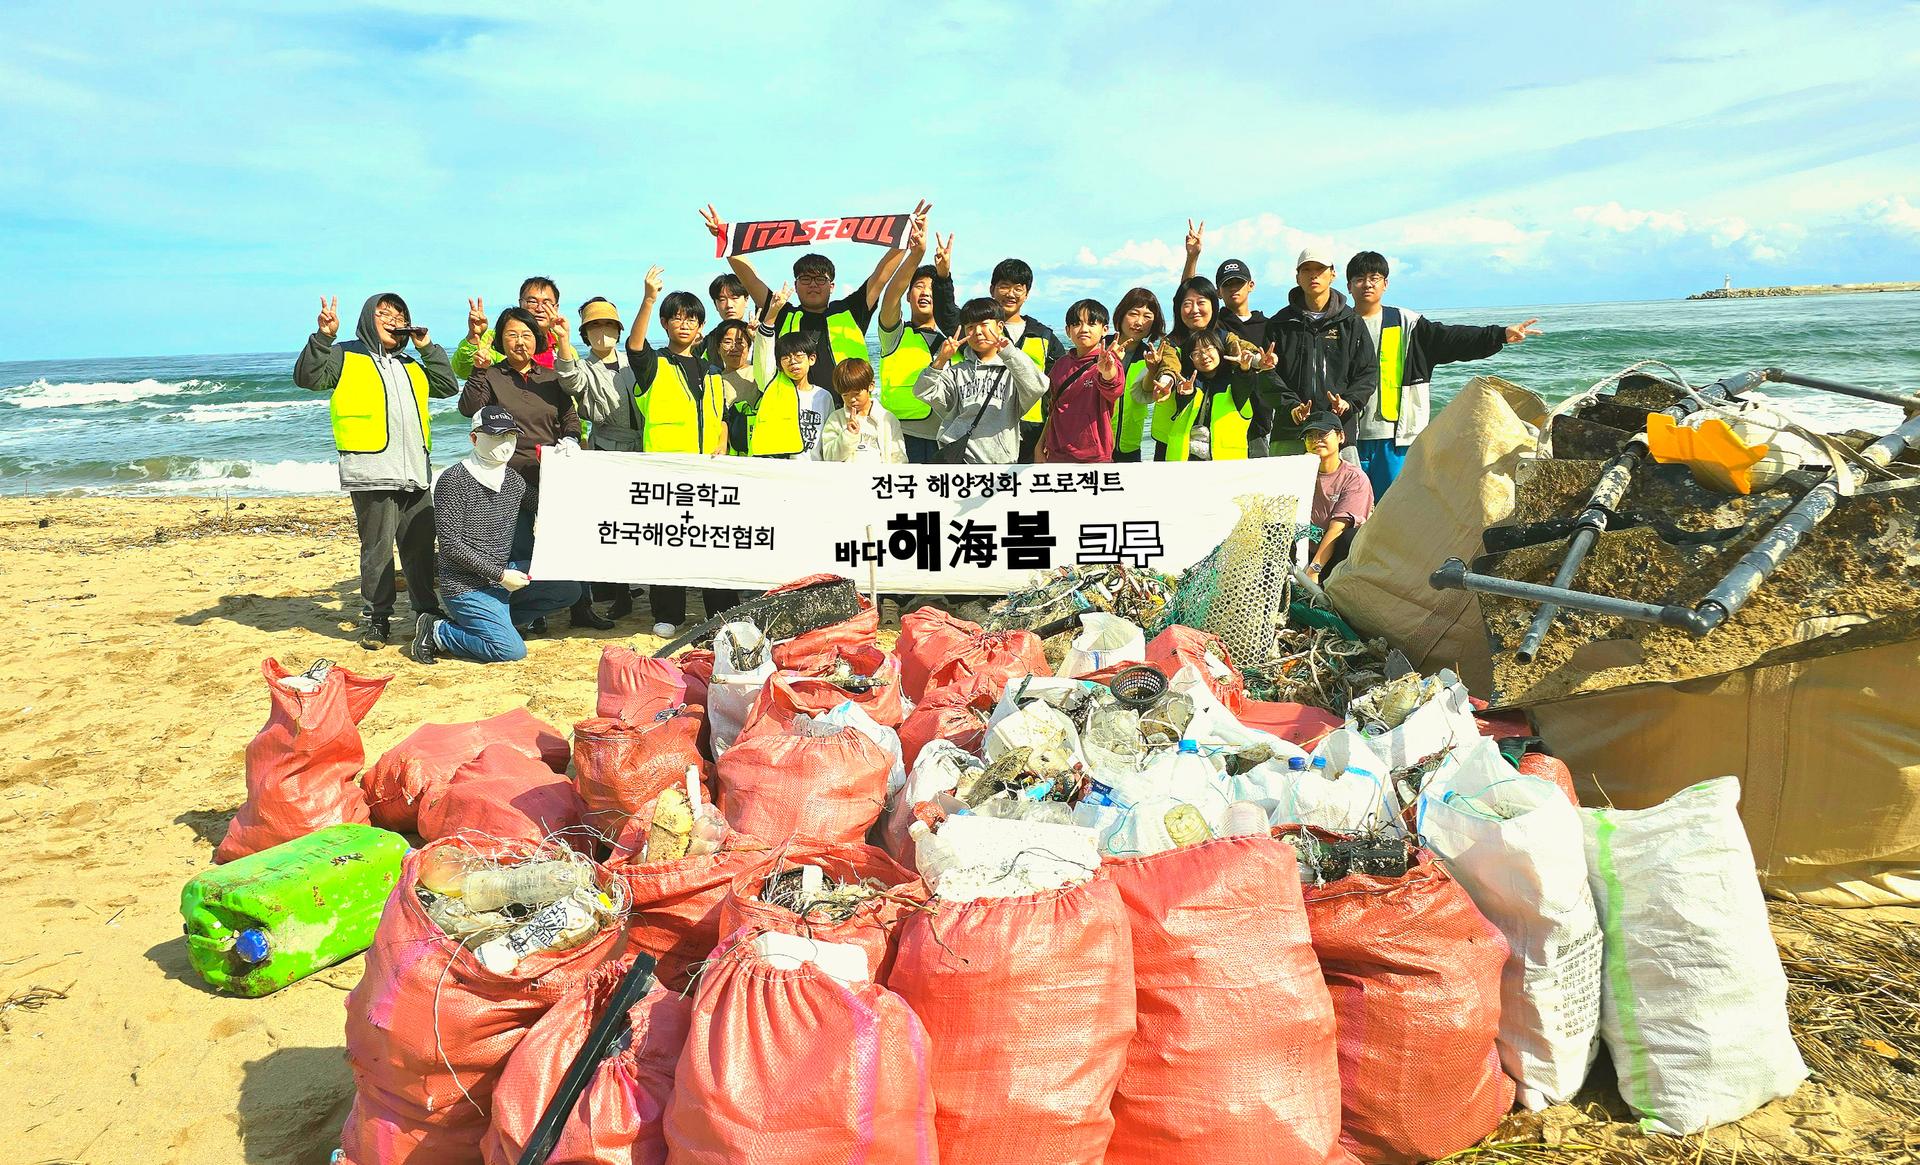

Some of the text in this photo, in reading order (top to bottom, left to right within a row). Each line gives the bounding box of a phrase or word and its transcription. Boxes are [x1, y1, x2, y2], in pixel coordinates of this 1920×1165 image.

[741, 216, 896, 251] ITASEOUL
[629, 481, 741, 508] 꿈마을학교
[871, 470, 1125, 500] 전국 해양정화 프로젝트
[597, 520, 775, 551] 한국해양안전협회
[835, 539, 887, 568] 바다
[1075, 520, 1164, 569] 크루
